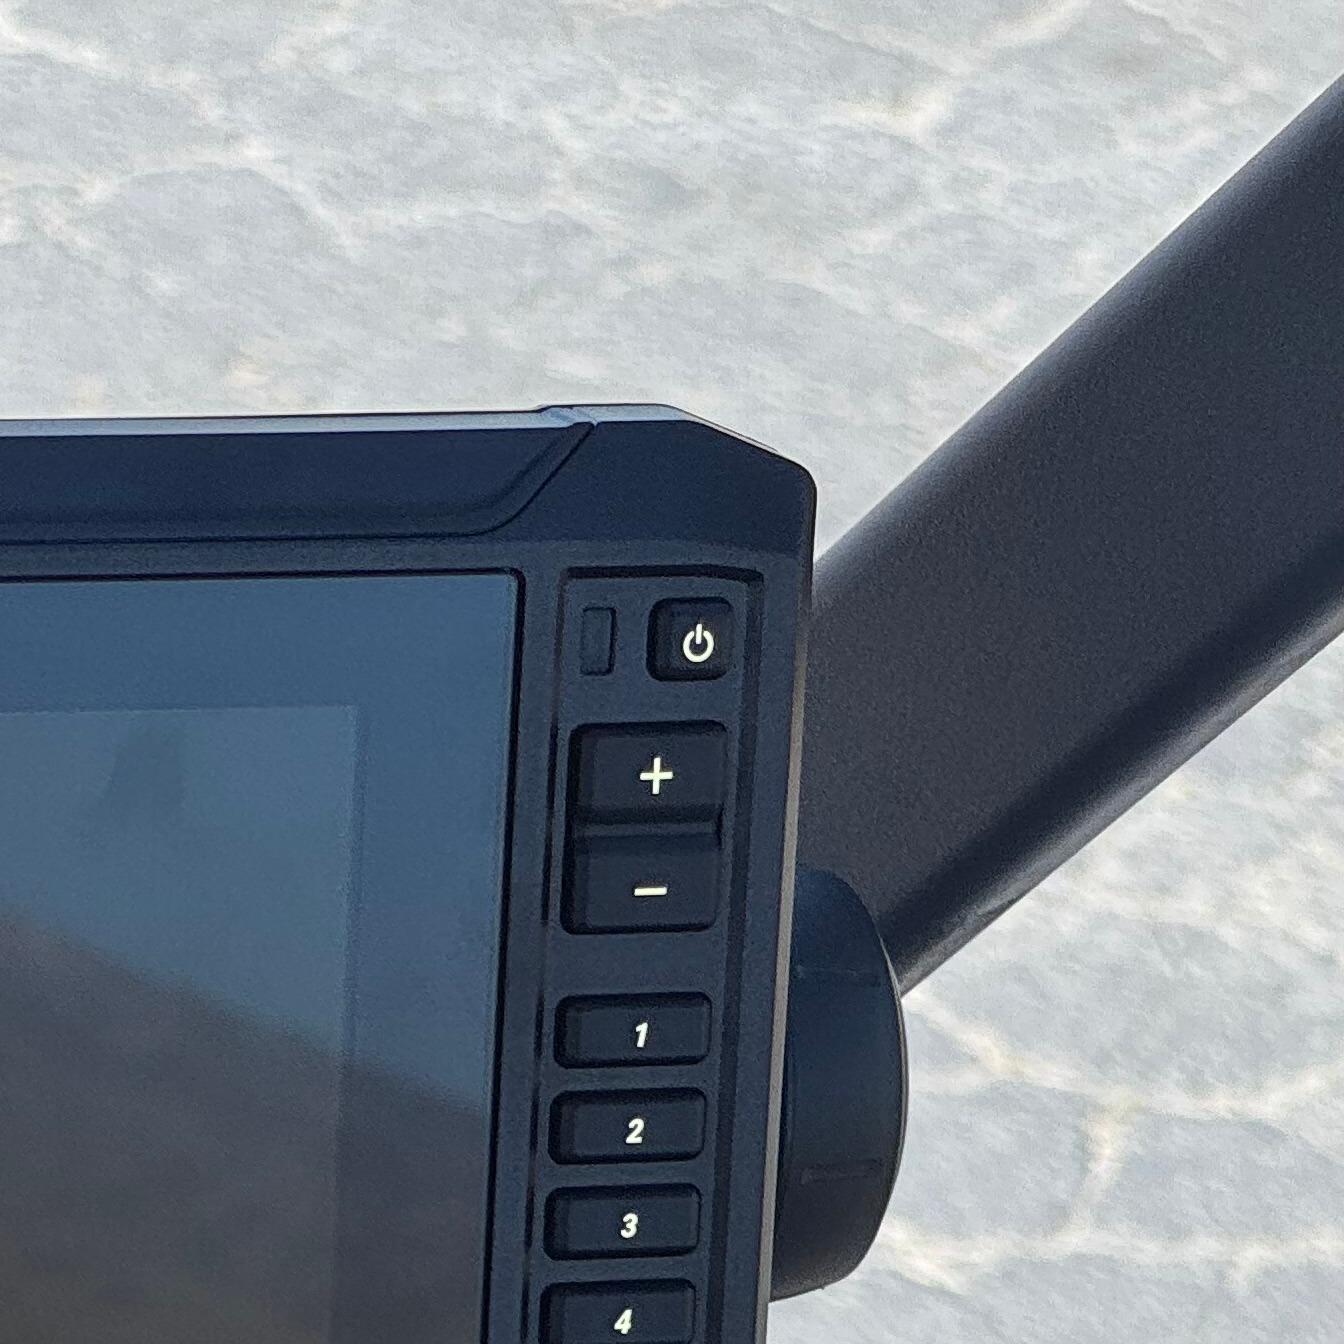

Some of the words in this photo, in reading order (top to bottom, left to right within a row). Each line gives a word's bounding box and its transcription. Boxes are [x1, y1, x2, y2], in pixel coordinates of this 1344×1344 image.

[636, 1023, 648, 1047] 1
[626, 1118, 644, 1143] 2
[621, 1213, 638, 1238] 3
[614, 1309, 632, 1334] 4
